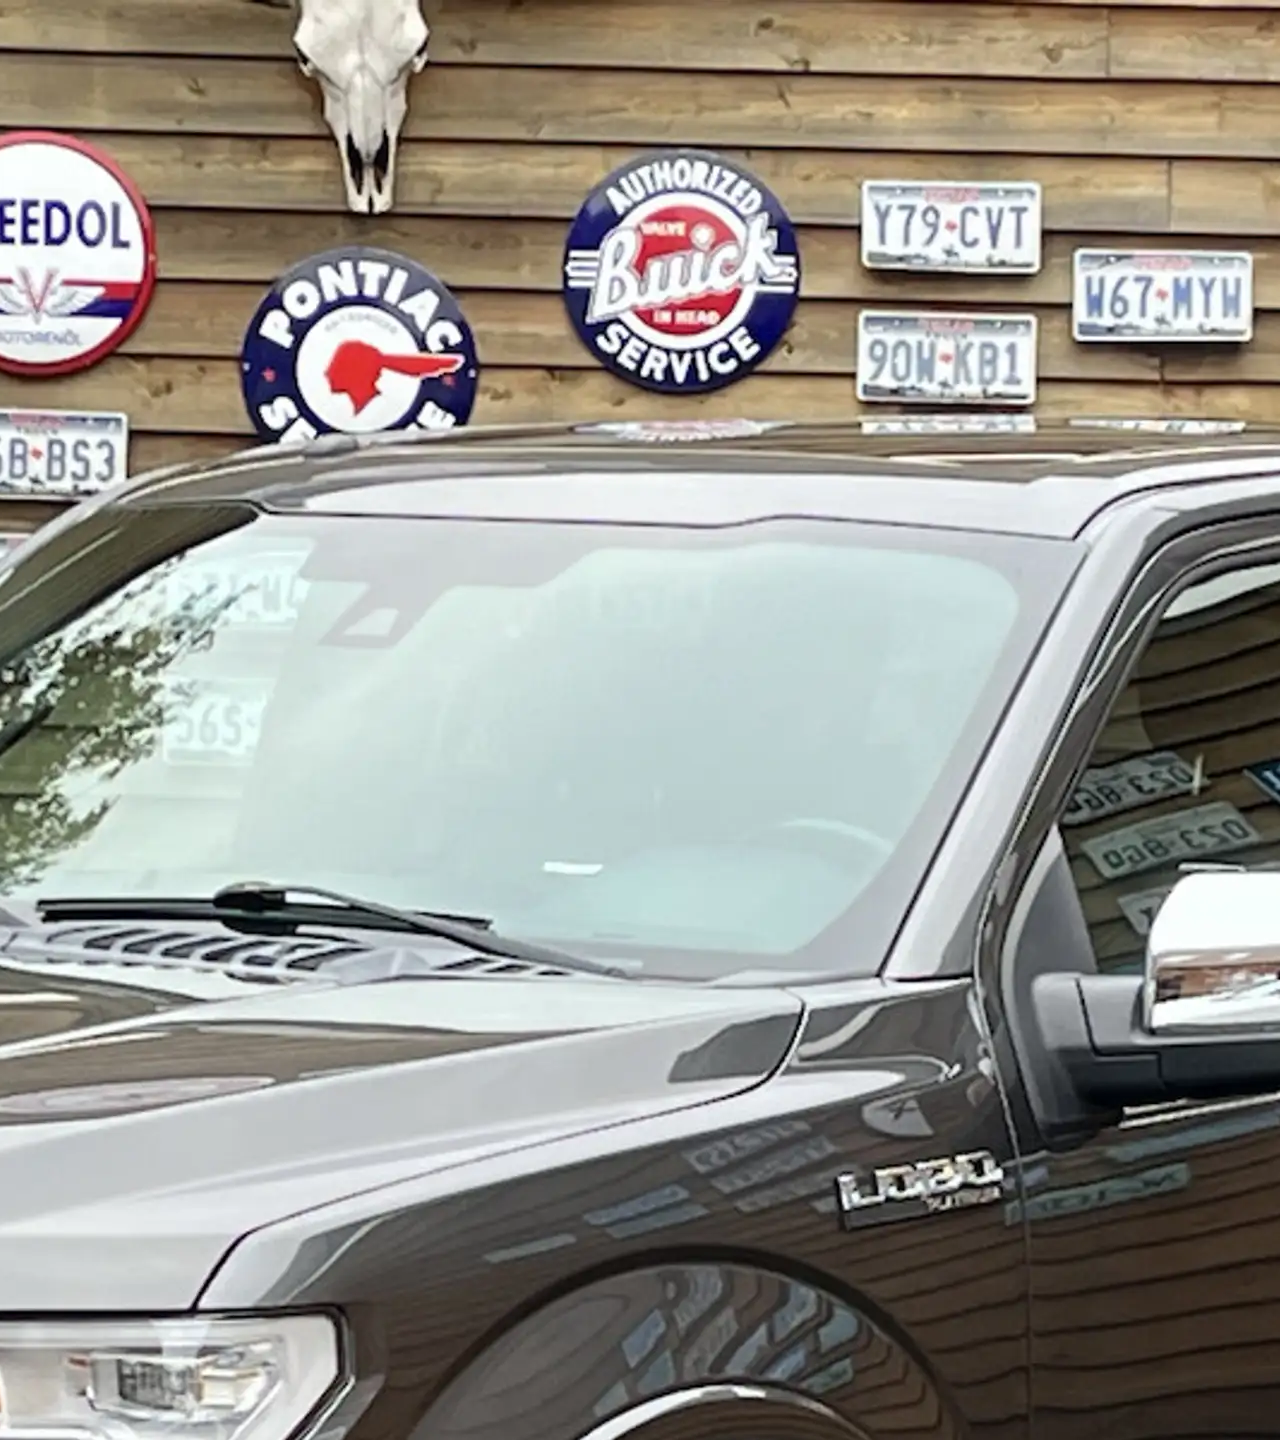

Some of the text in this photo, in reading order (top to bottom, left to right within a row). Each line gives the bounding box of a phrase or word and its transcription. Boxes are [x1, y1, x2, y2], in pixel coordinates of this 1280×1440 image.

[605, 158, 762, 215] AUTHORIZED
[259, 260, 463, 352] PONTIAC
[585, 212, 798, 325] Buick
[596, 323, 761, 384] SERVICE
